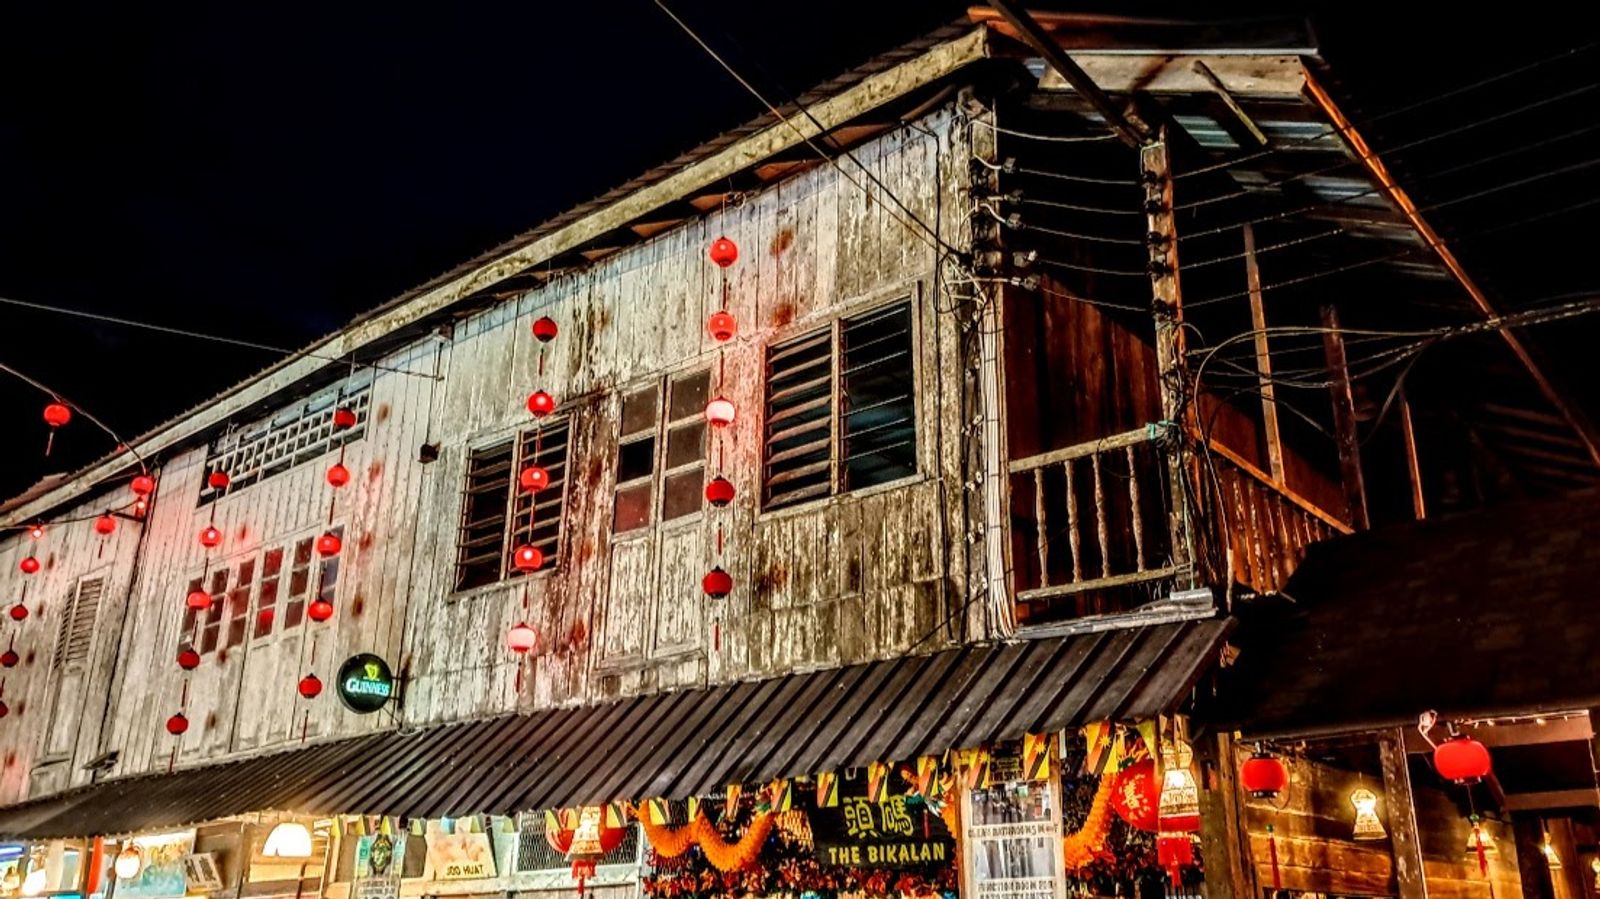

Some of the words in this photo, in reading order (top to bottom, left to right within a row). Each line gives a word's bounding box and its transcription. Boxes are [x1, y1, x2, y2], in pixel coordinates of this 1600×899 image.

[345, 677, 390, 697] GUINNESS
[828, 846, 861, 865] THE
[868, 842, 946, 864] BIKALAN
[463, 864, 484, 875] HUAT
